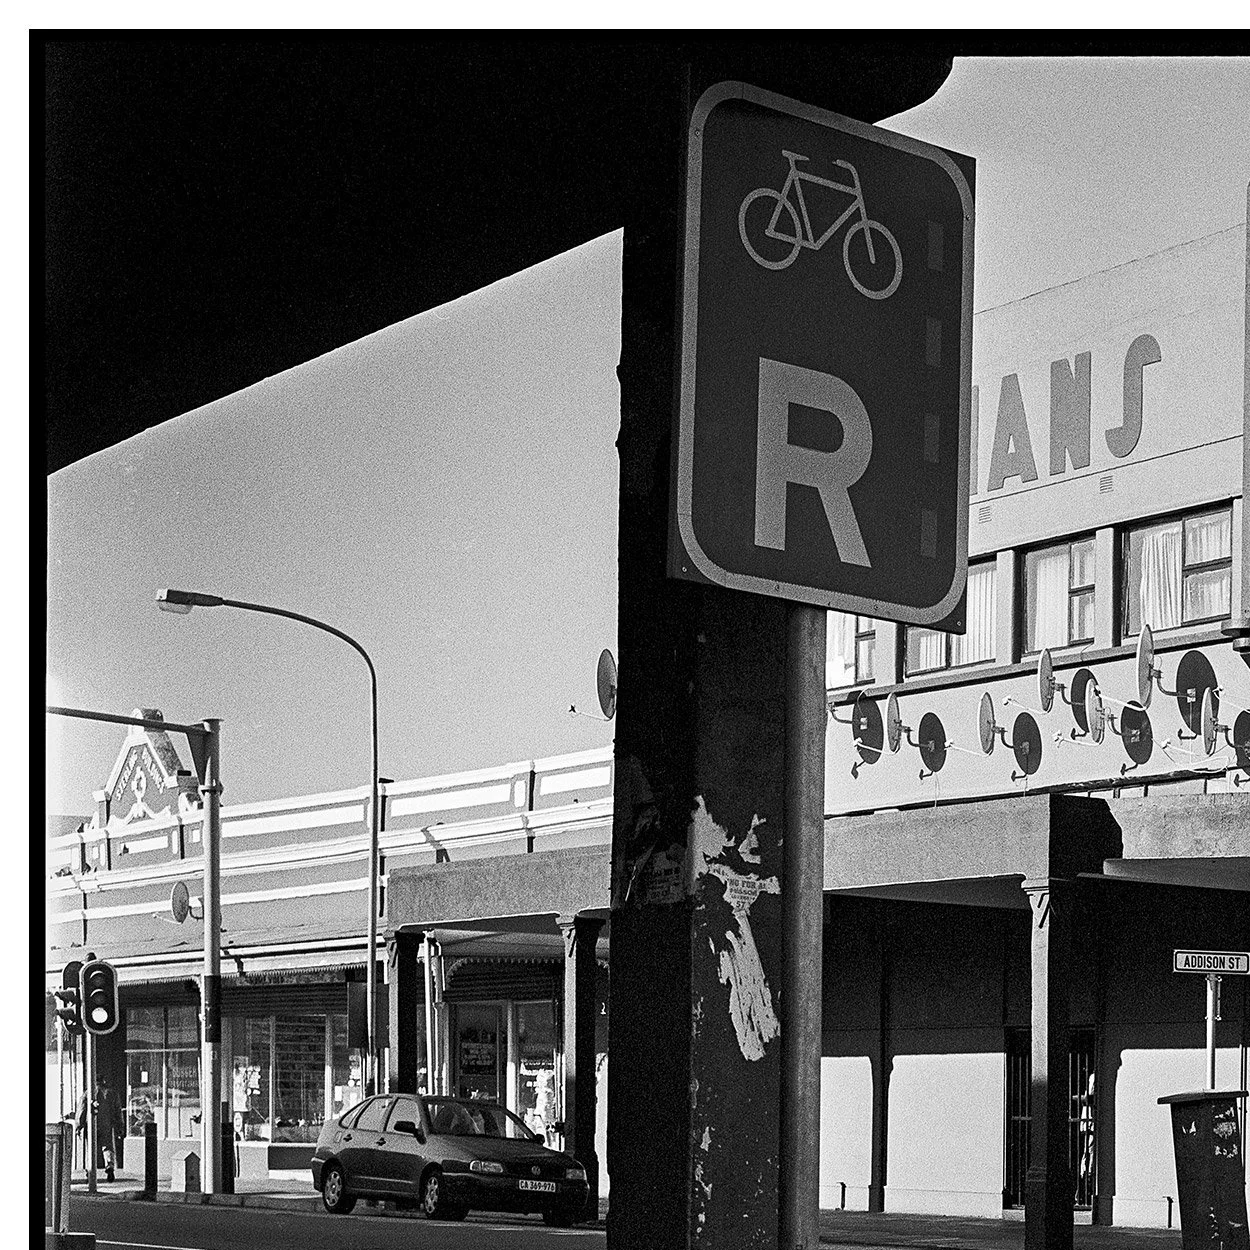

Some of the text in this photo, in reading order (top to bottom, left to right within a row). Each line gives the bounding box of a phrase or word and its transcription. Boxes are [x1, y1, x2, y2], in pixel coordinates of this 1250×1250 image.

[754, 356, 873, 568] R
[970, 334, 1162, 495] ANS
[1183, 955, 1241, 970] ADDISON ST
